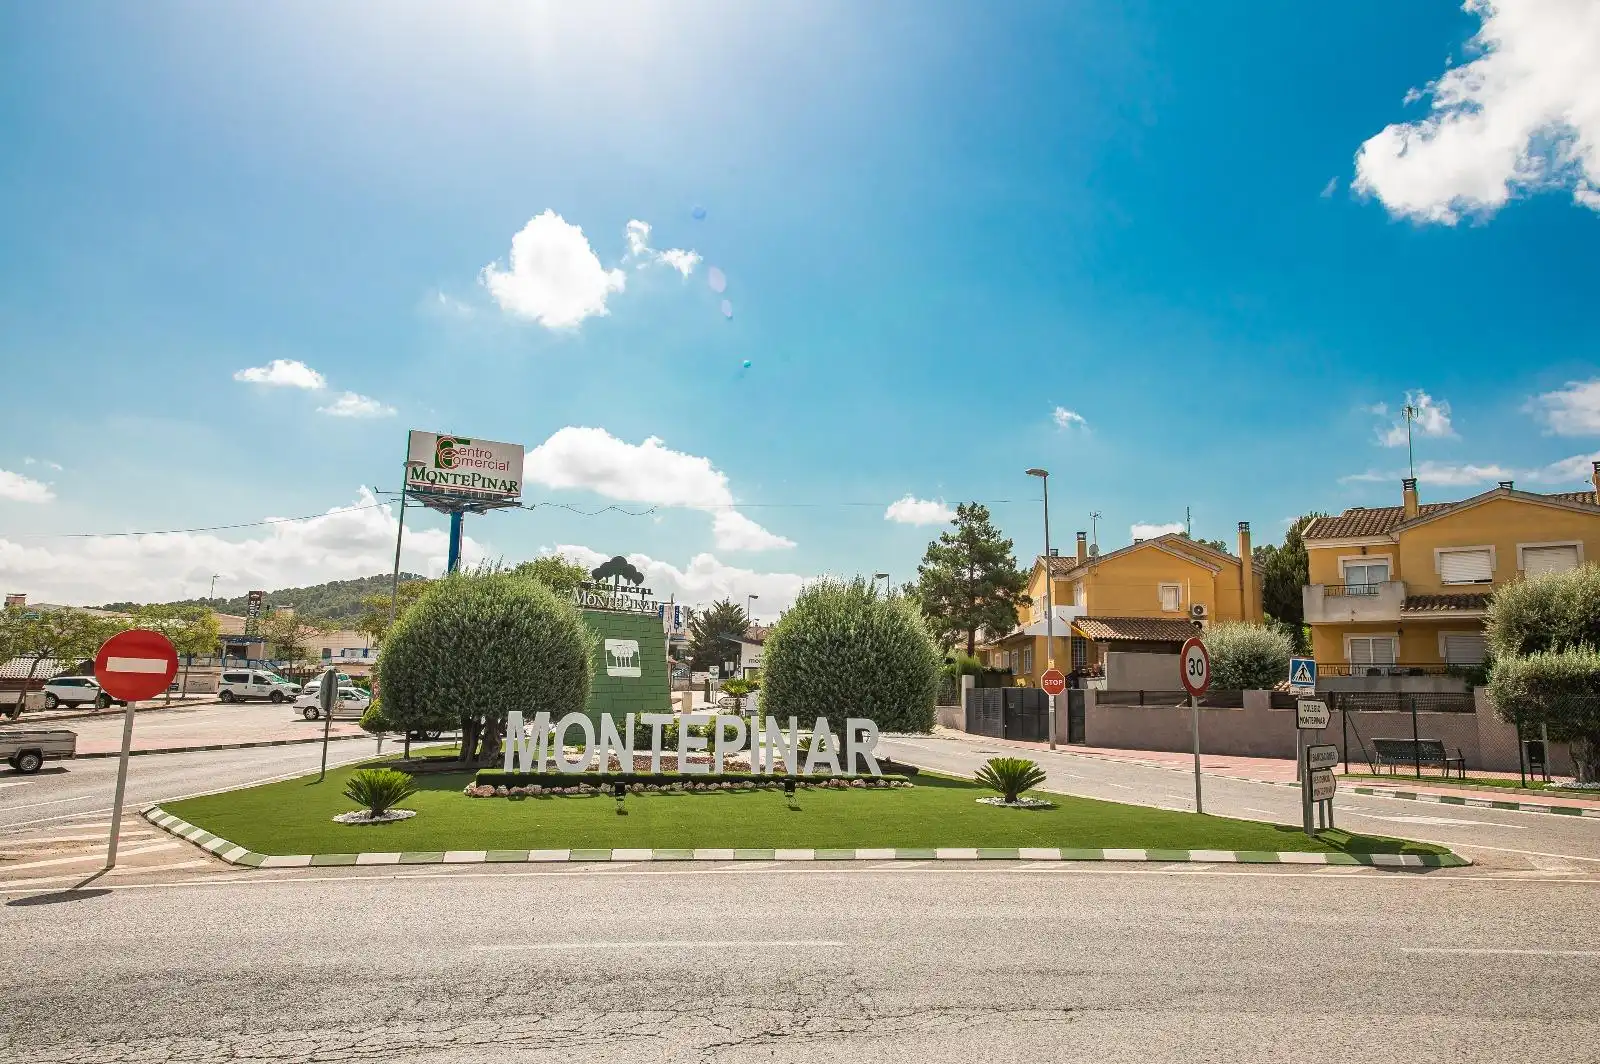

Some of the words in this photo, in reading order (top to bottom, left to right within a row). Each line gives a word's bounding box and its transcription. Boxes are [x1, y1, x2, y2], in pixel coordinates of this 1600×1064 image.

[436, 435, 493, 460] Centro
[440, 447, 510, 471] Comercial
[1188, 657, 1204, 677] 30
[503, 710, 884, 776] MONTEPINAR
